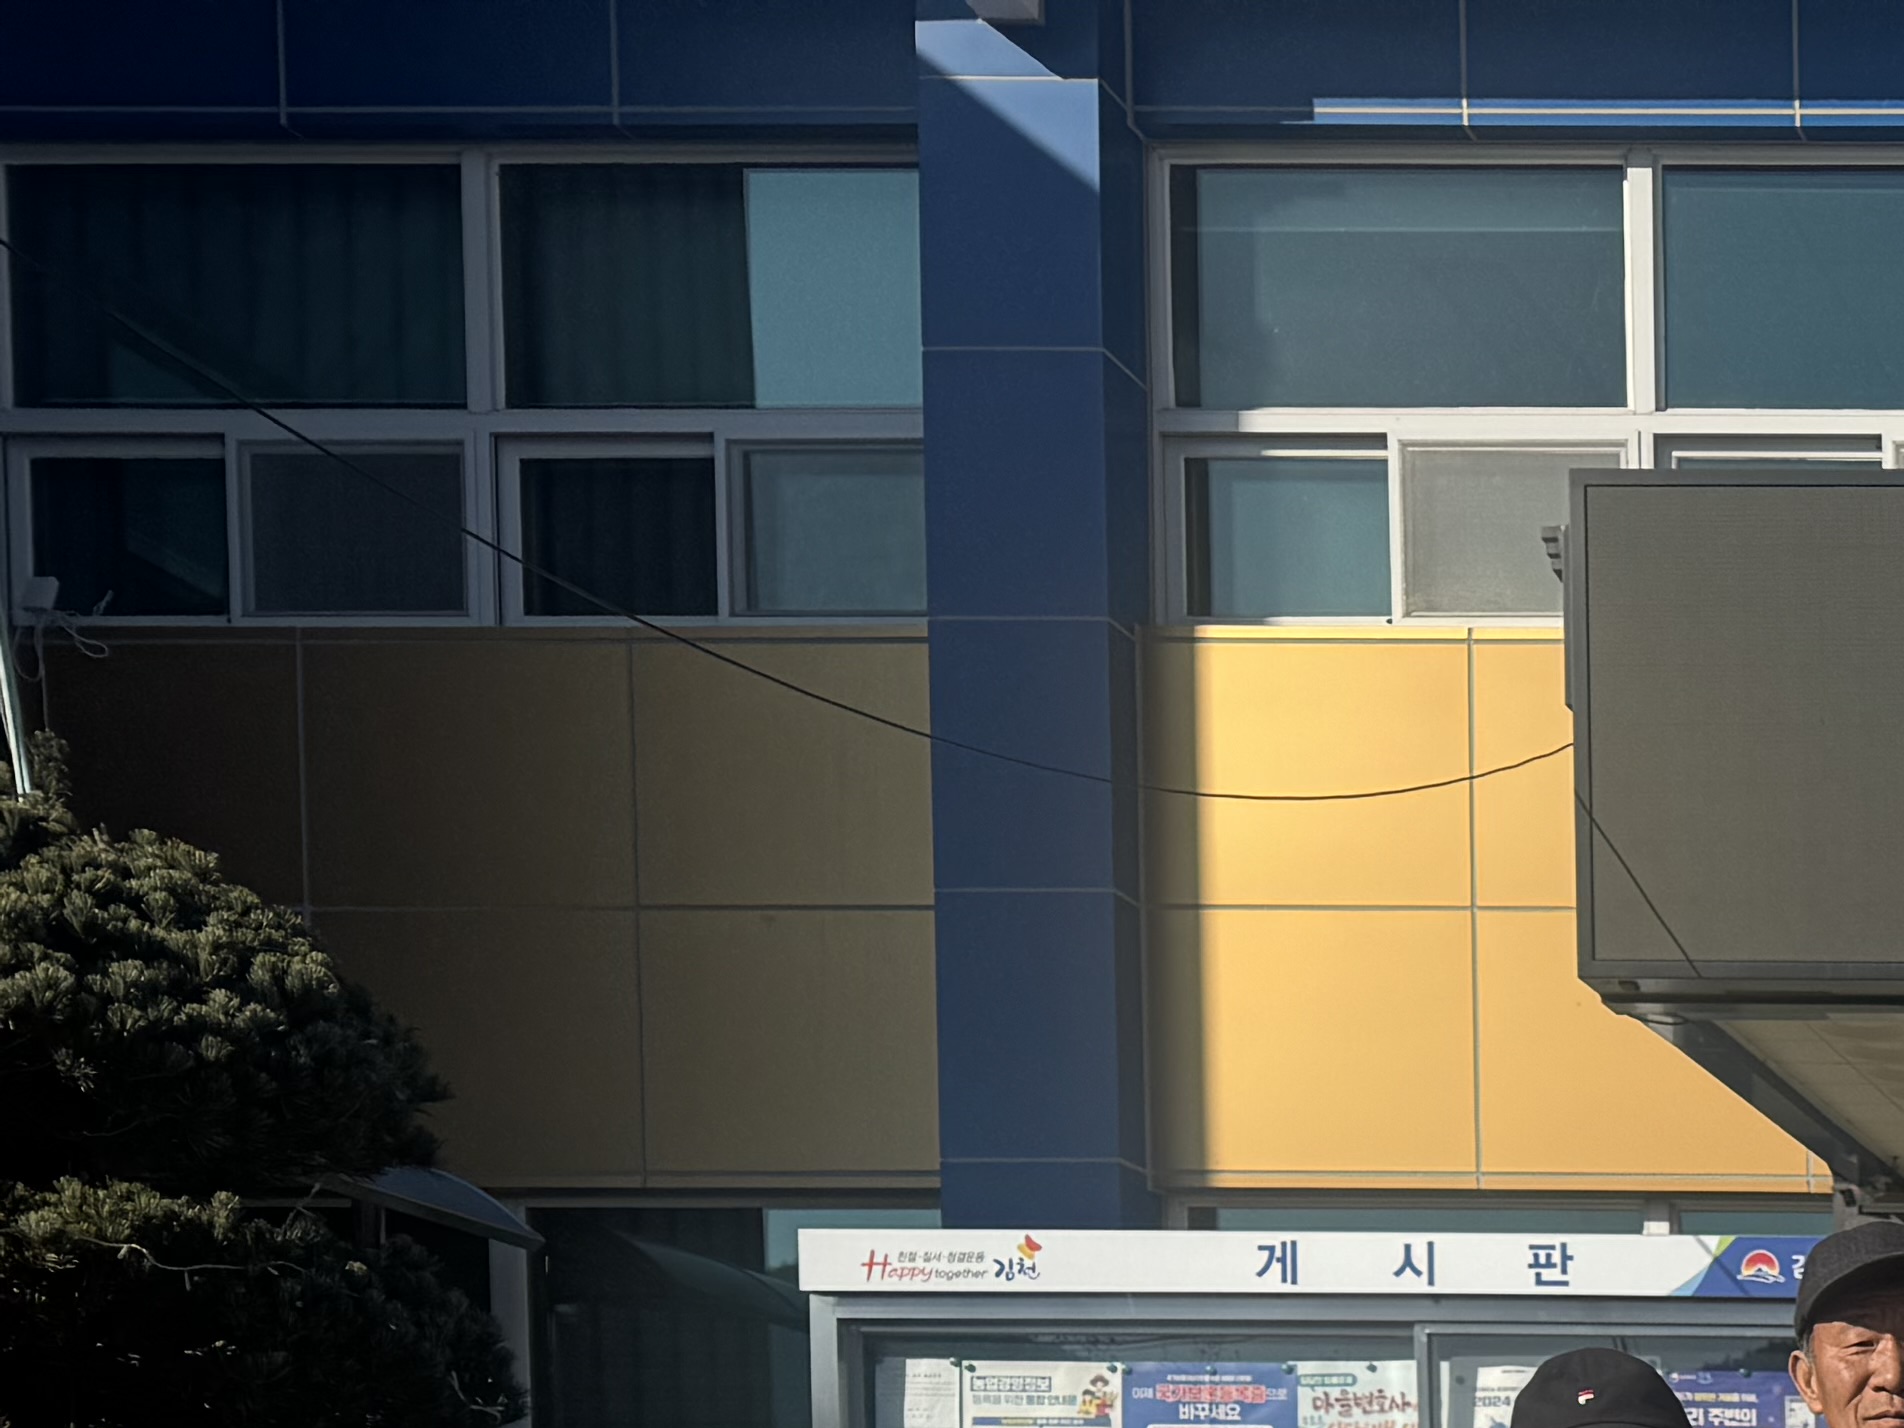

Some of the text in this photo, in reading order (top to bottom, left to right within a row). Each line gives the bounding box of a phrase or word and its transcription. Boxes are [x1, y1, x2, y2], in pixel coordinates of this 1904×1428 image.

[860, 1248, 989, 1283] Happy together
[993, 1256, 1042, 1282] 김천
[1178, 1403, 1241, 1420] 바꾸세요
[1312, 1388, 1417, 1418] 마을변호사
